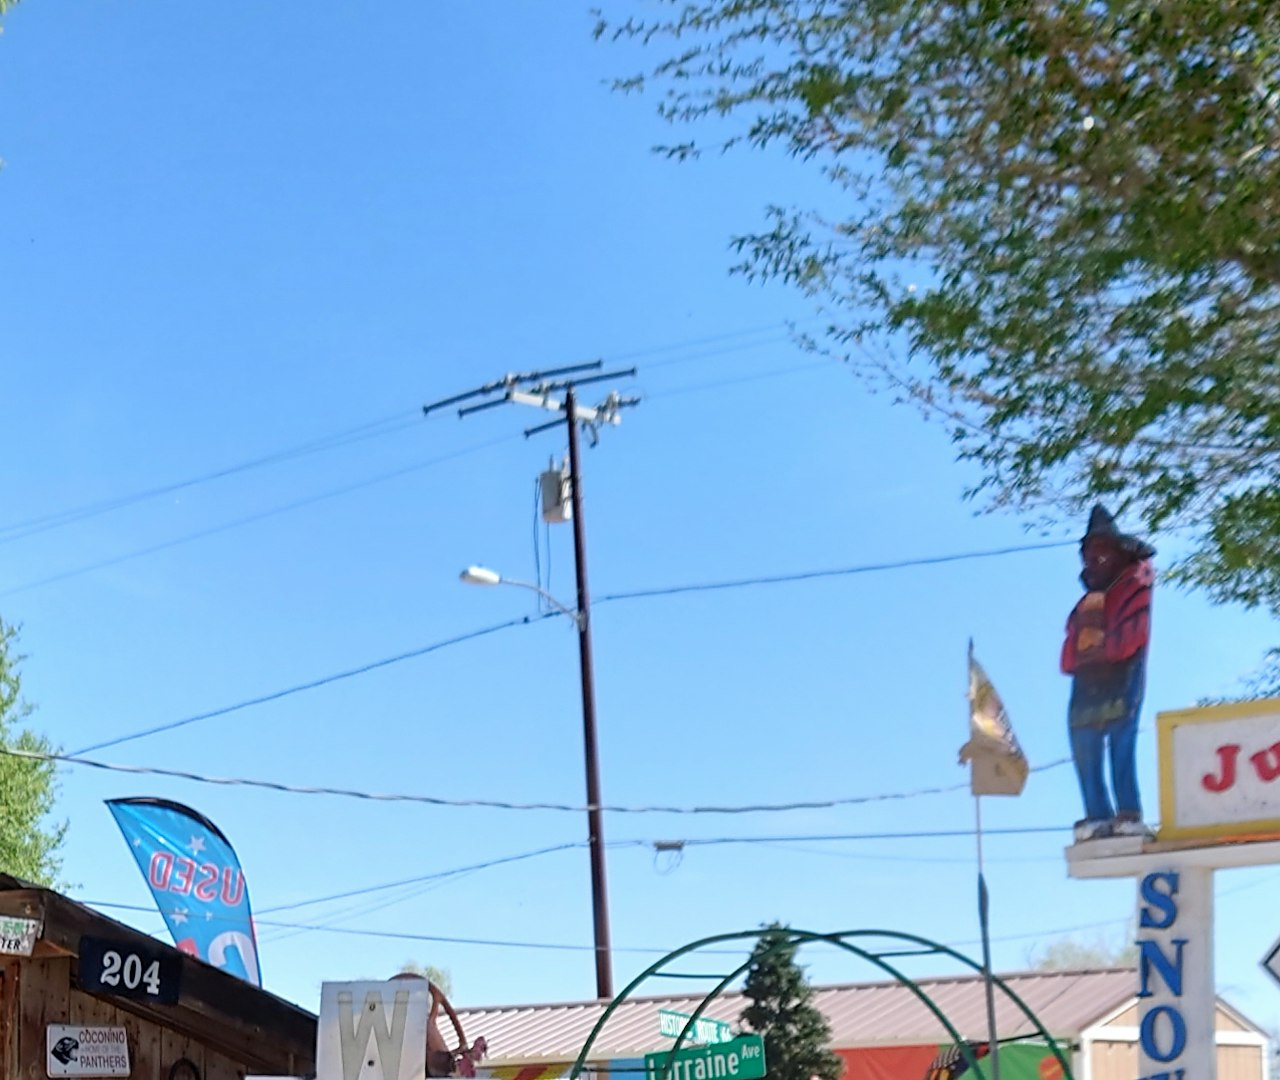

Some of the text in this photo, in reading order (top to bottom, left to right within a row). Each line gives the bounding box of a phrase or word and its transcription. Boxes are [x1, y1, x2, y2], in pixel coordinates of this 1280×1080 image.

[99, 949, 162, 996] 204
[79, 1030, 125, 1044] COCONINO
[741, 1043, 760, 1060] Ave
[80, 1055, 127, 1069] PANTHERS
